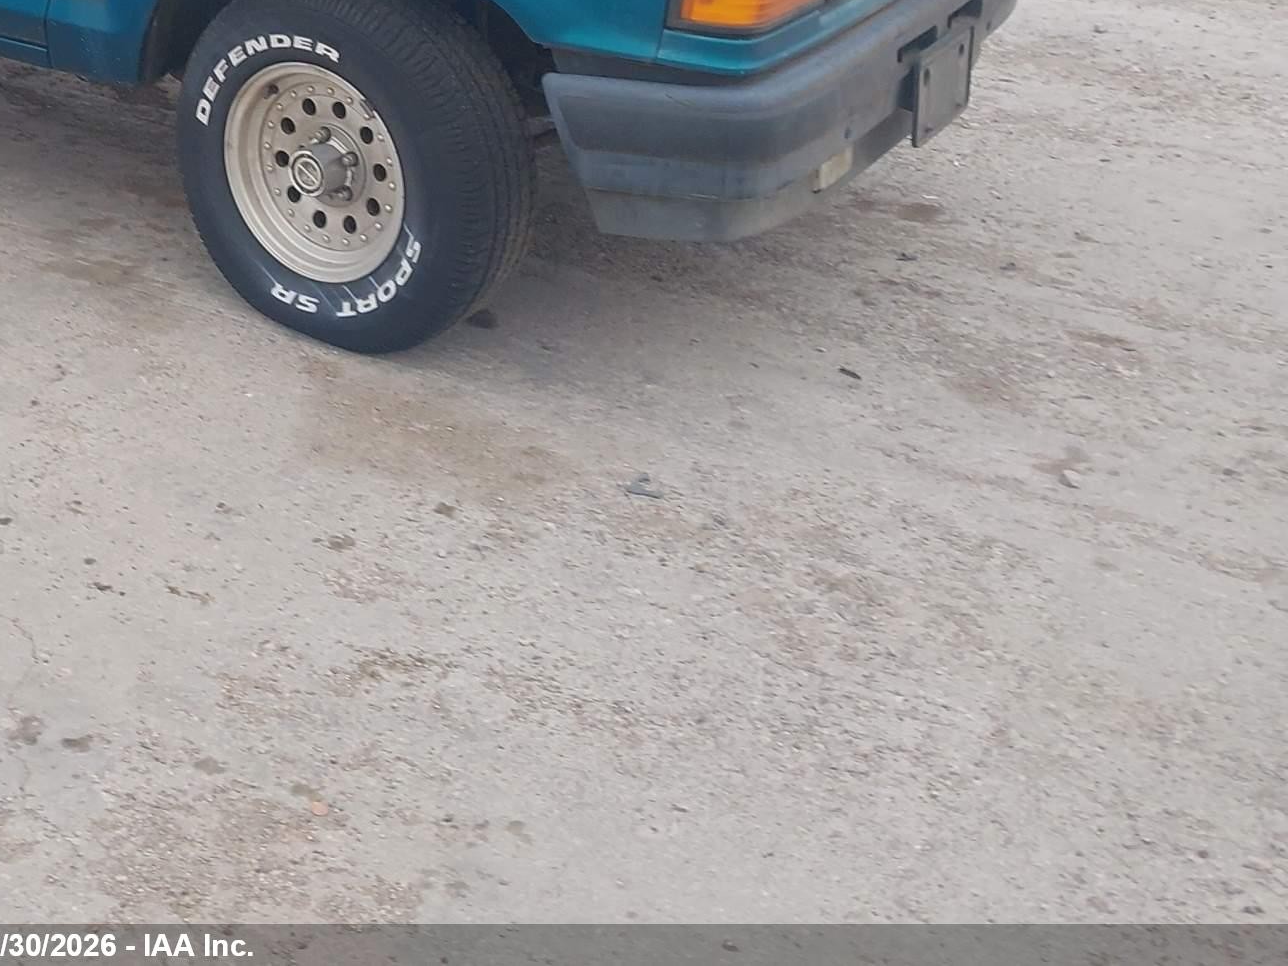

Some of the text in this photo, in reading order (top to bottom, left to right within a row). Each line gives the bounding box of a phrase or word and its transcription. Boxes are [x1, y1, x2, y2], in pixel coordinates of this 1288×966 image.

[195, 34, 340, 127] DEFENDER
[270, 240, 422, 318] SPORT SR
